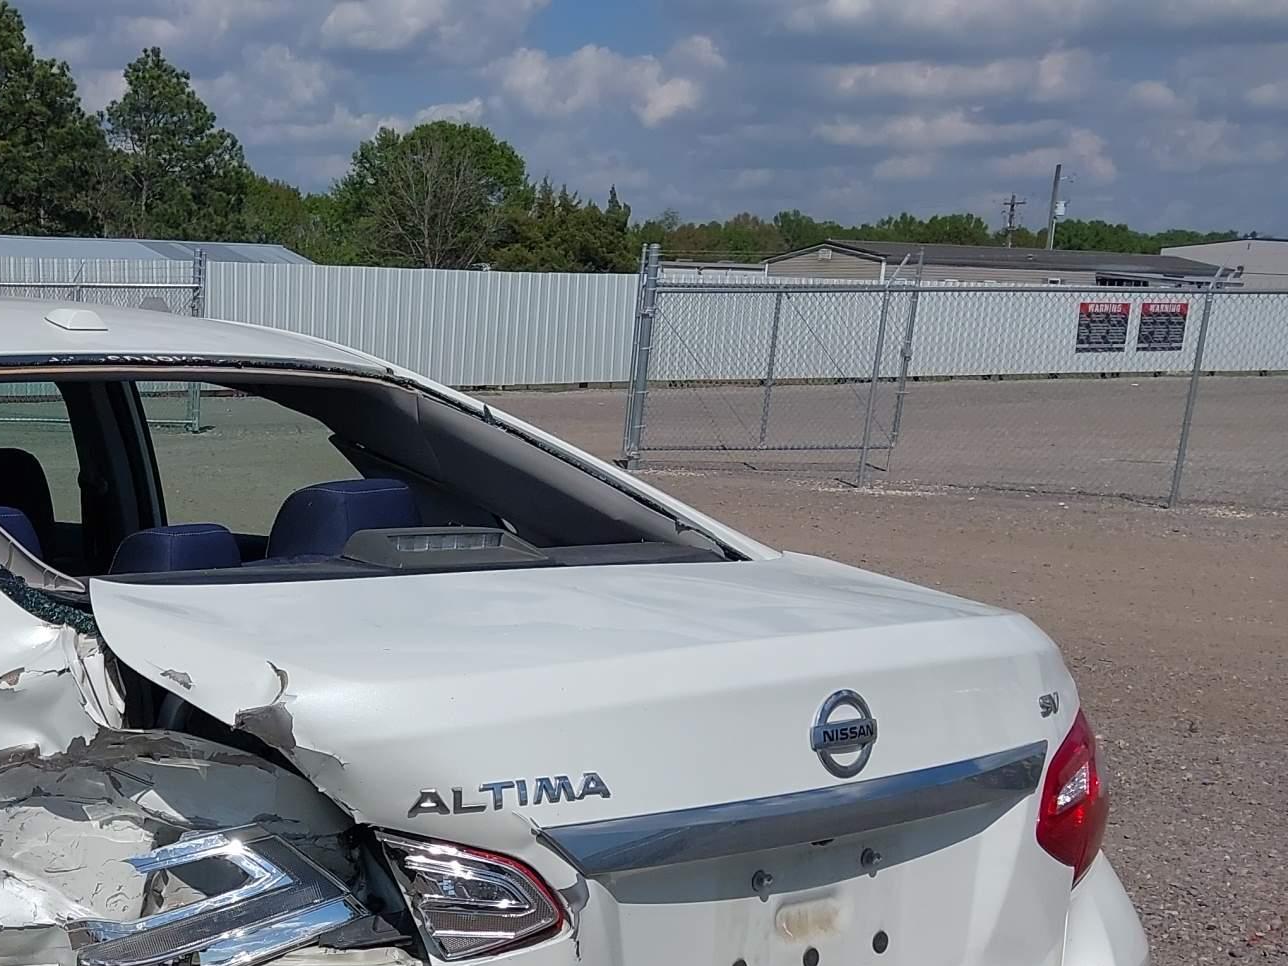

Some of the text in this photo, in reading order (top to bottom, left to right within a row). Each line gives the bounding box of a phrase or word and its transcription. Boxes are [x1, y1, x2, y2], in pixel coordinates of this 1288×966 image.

[1088, 303, 1122, 313] WARNING
[1149, 303, 1182, 313] WARNING
[1039, 691, 1059, 718] SV
[822, 723, 874, 743] NISSAN
[407, 771, 612, 818] ALTIMA
